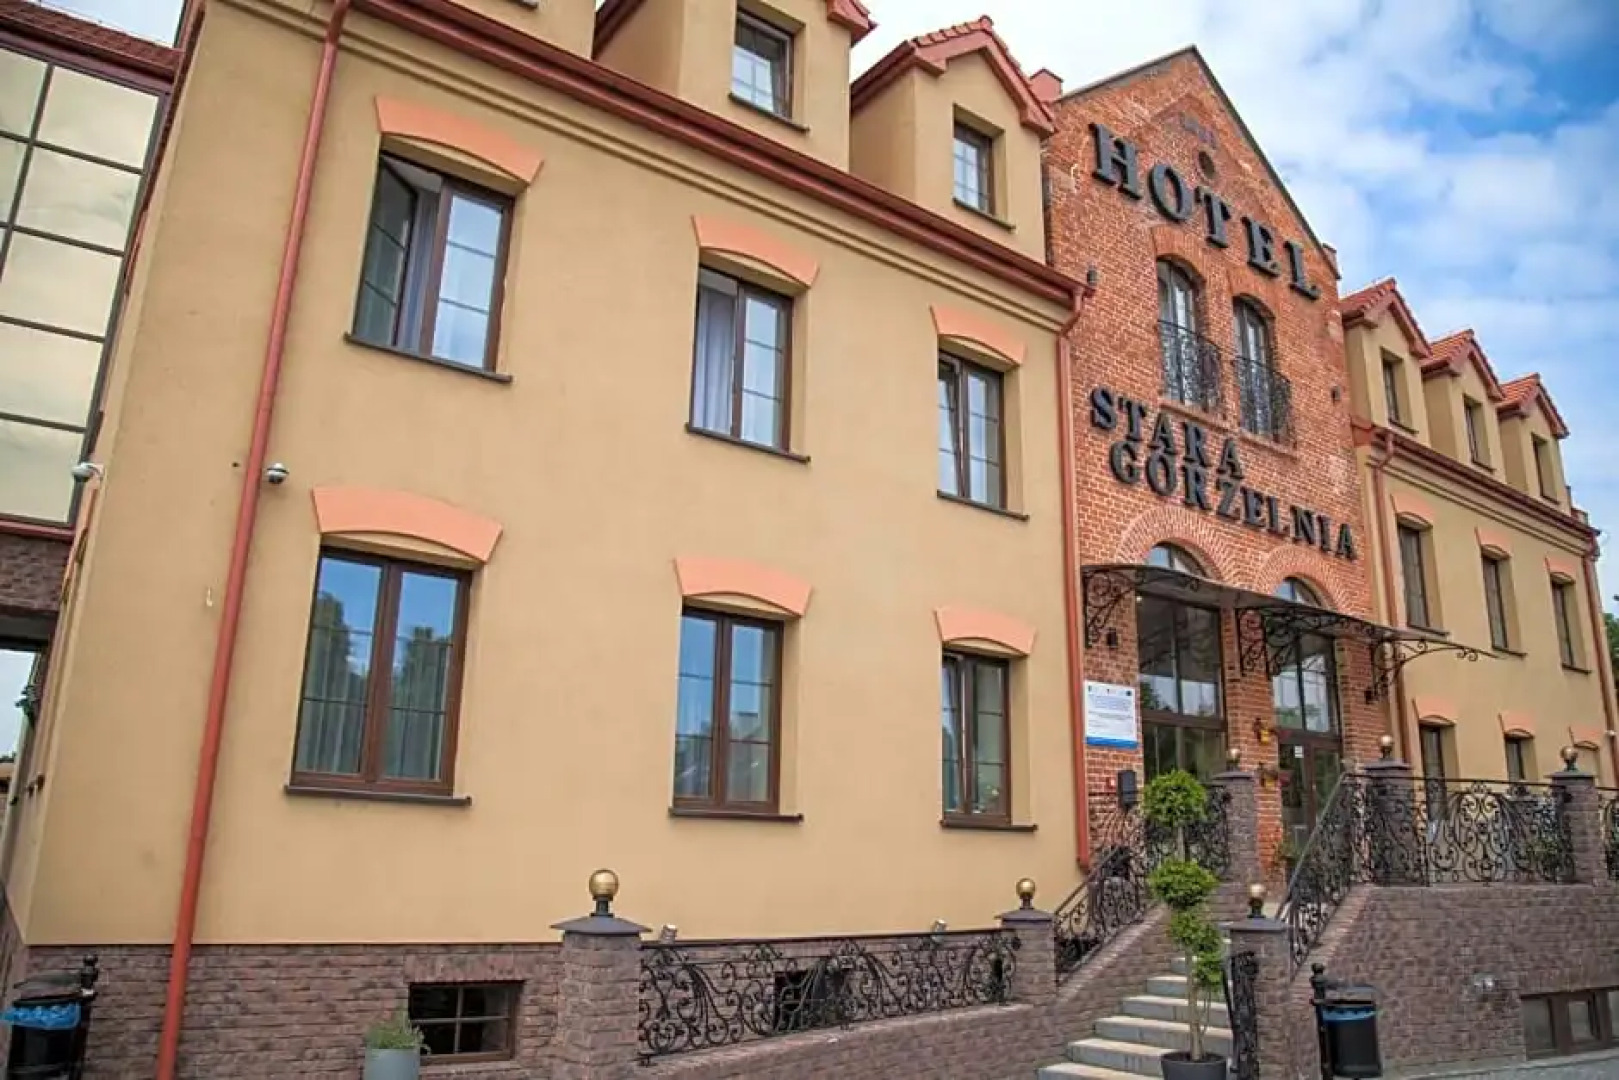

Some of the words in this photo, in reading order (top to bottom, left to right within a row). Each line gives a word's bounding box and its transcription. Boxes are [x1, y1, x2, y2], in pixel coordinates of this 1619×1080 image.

[1090, 122, 1320, 300] HOTEL
[1090, 388, 1244, 480] STARA
[1110, 440, 1357, 561] GORZELNIA
